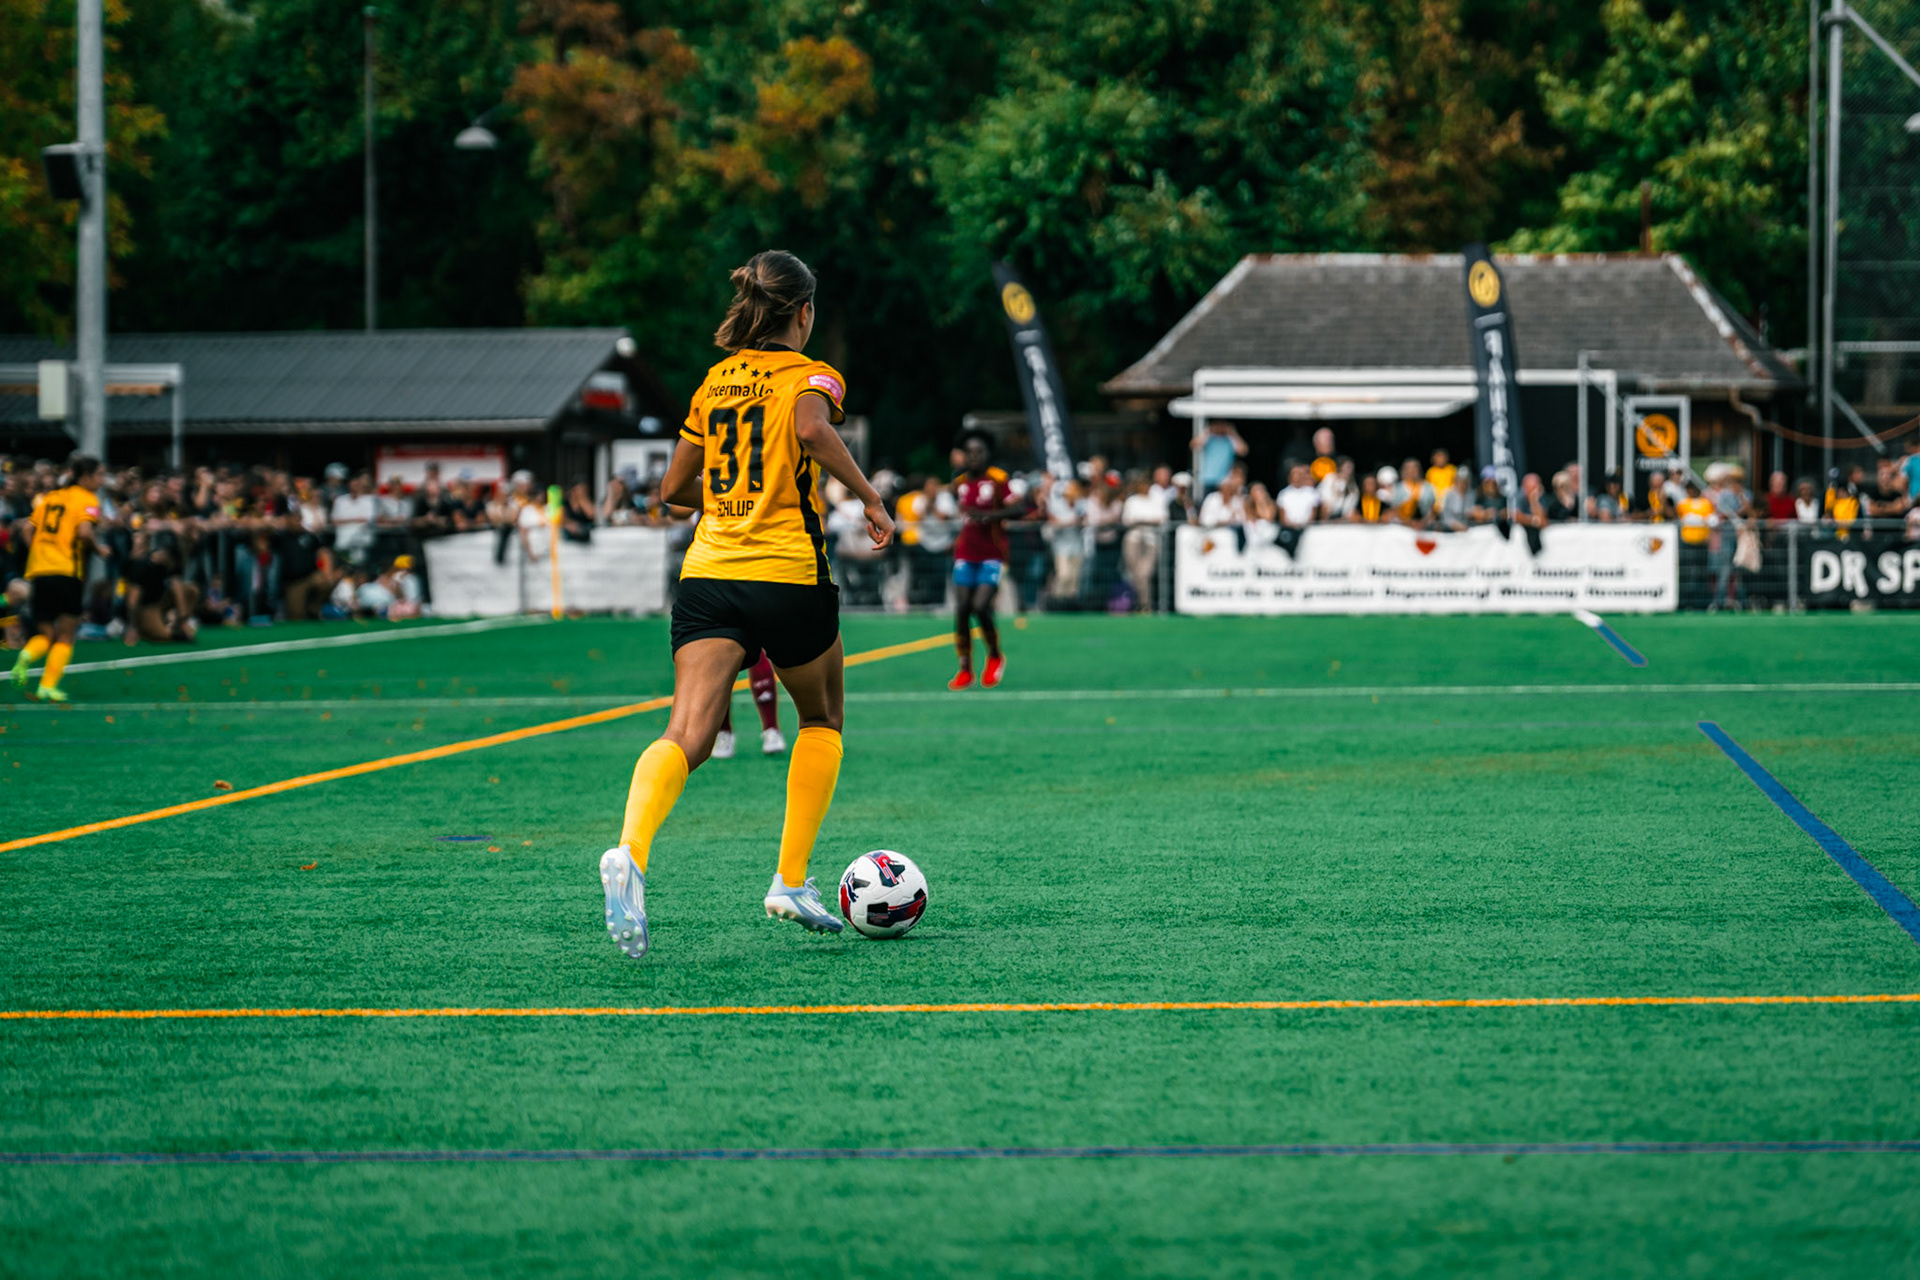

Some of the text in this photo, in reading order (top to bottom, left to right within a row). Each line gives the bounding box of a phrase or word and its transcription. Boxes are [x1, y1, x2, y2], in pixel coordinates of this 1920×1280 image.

[709, 404, 766, 495] 31
[42, 503, 66, 534] 13
[1810, 550, 1869, 598] DR
